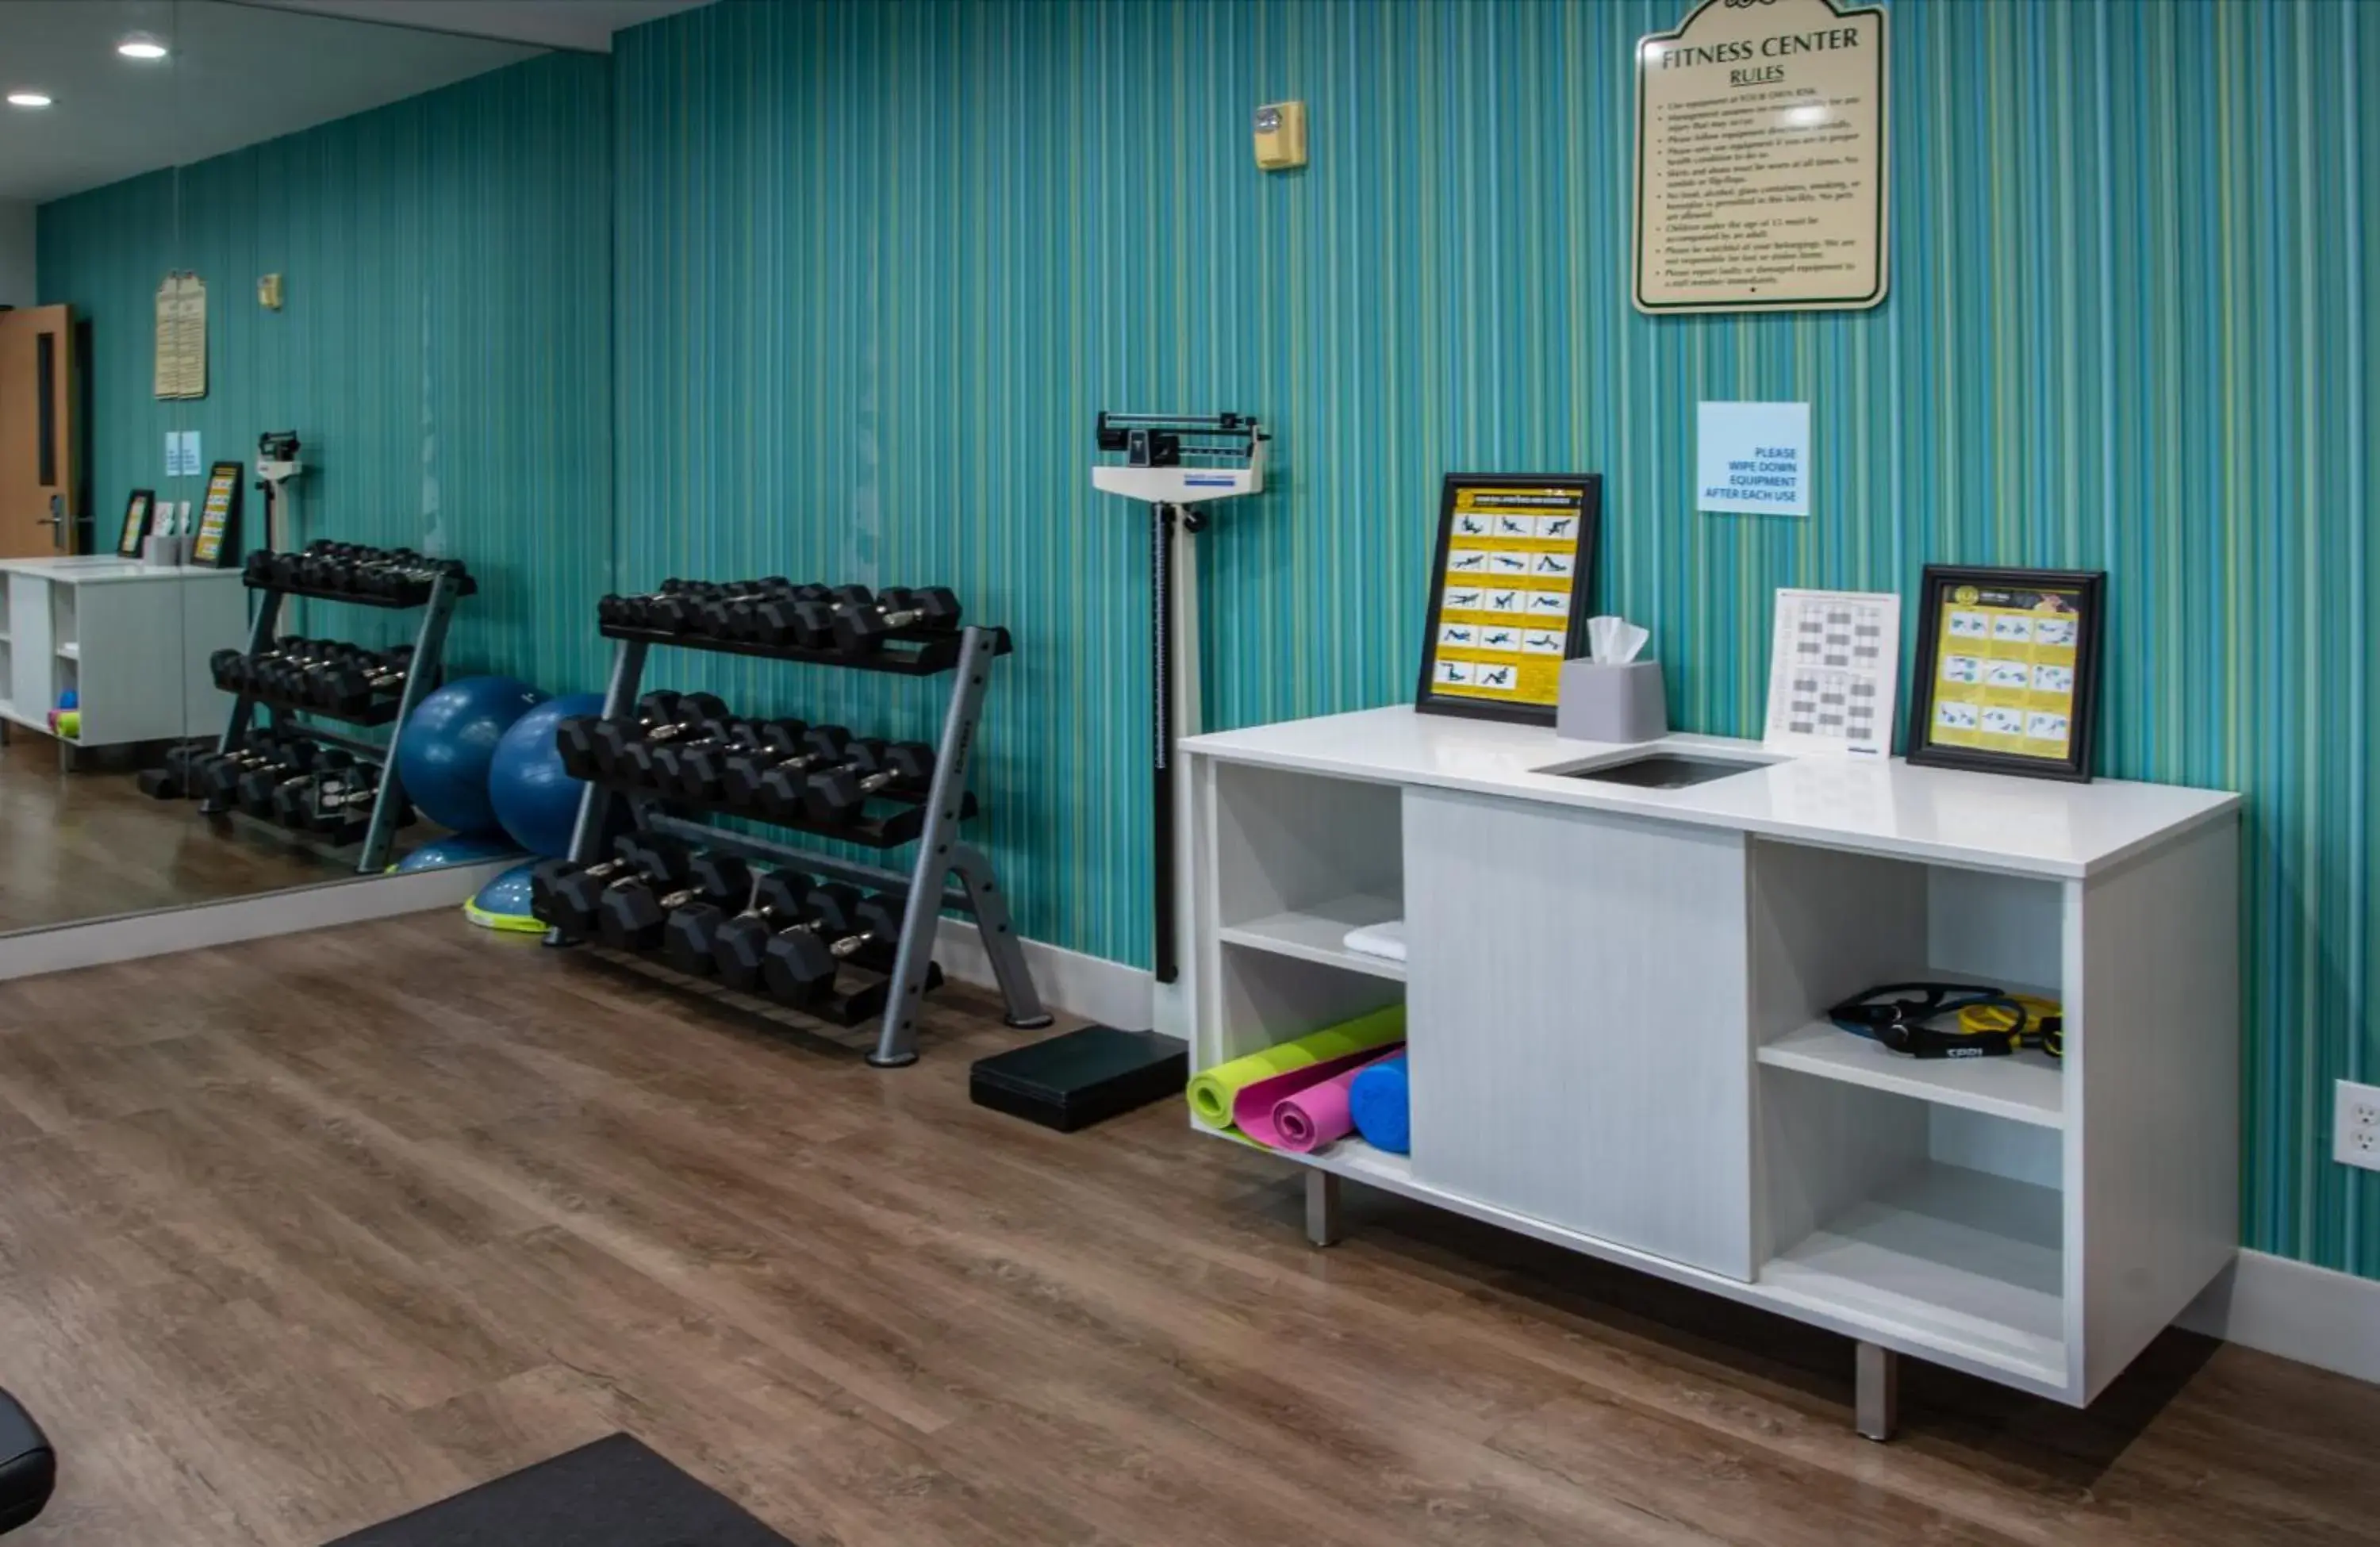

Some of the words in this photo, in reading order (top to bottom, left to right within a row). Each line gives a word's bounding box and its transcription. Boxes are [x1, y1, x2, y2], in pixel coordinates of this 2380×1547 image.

[1663, 40, 1753, 70] FITNESS
[1761, 27, 1860, 58] CENTER
[1729, 64, 1785, 85] RULES
[1755, 447, 1796, 459] PLEASE
[1728, 461, 1756, 471] WIPE
[1759, 462, 1797, 473] DOWN
[1729, 474, 1797, 487] EQUIPMENT
[1705, 487, 1739, 499] AFTER
[1741, 489, 1772, 501] EACH
[1775, 491, 1796, 502] USE
